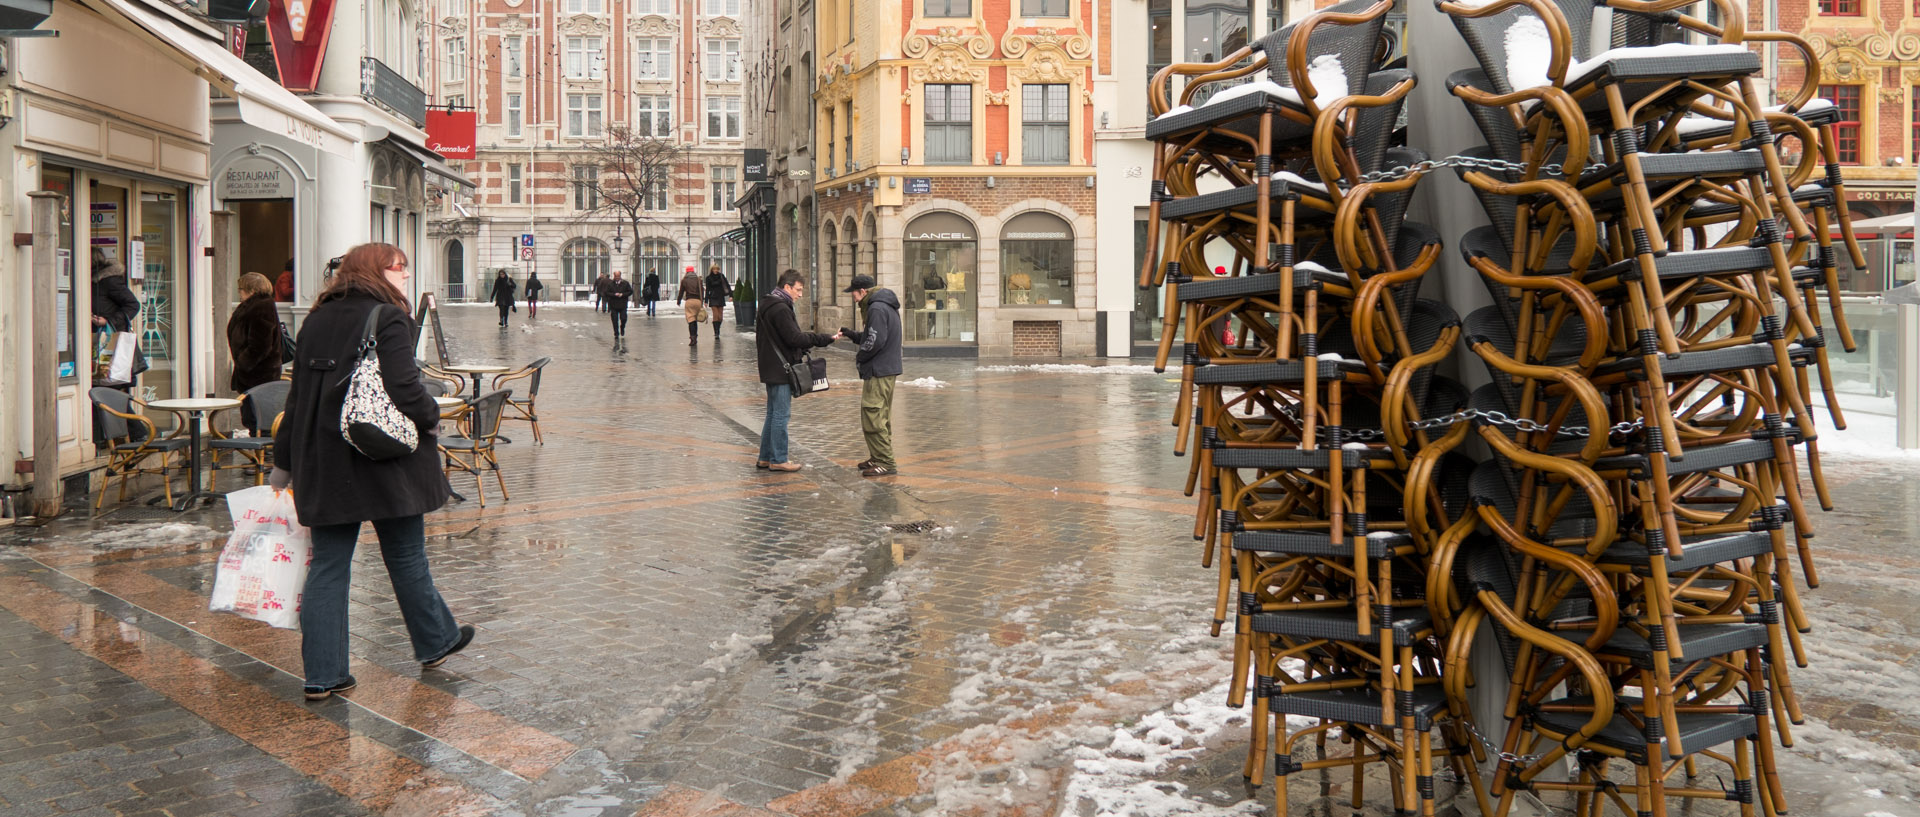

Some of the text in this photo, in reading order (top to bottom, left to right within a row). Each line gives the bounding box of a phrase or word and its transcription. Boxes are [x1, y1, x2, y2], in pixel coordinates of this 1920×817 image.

[286, 117, 298, 136] LA
[432, 142, 471, 153] Baccarat
[226, 171, 280, 181] RESTAURANT
[1857, 192, 1880, 201] COQ
